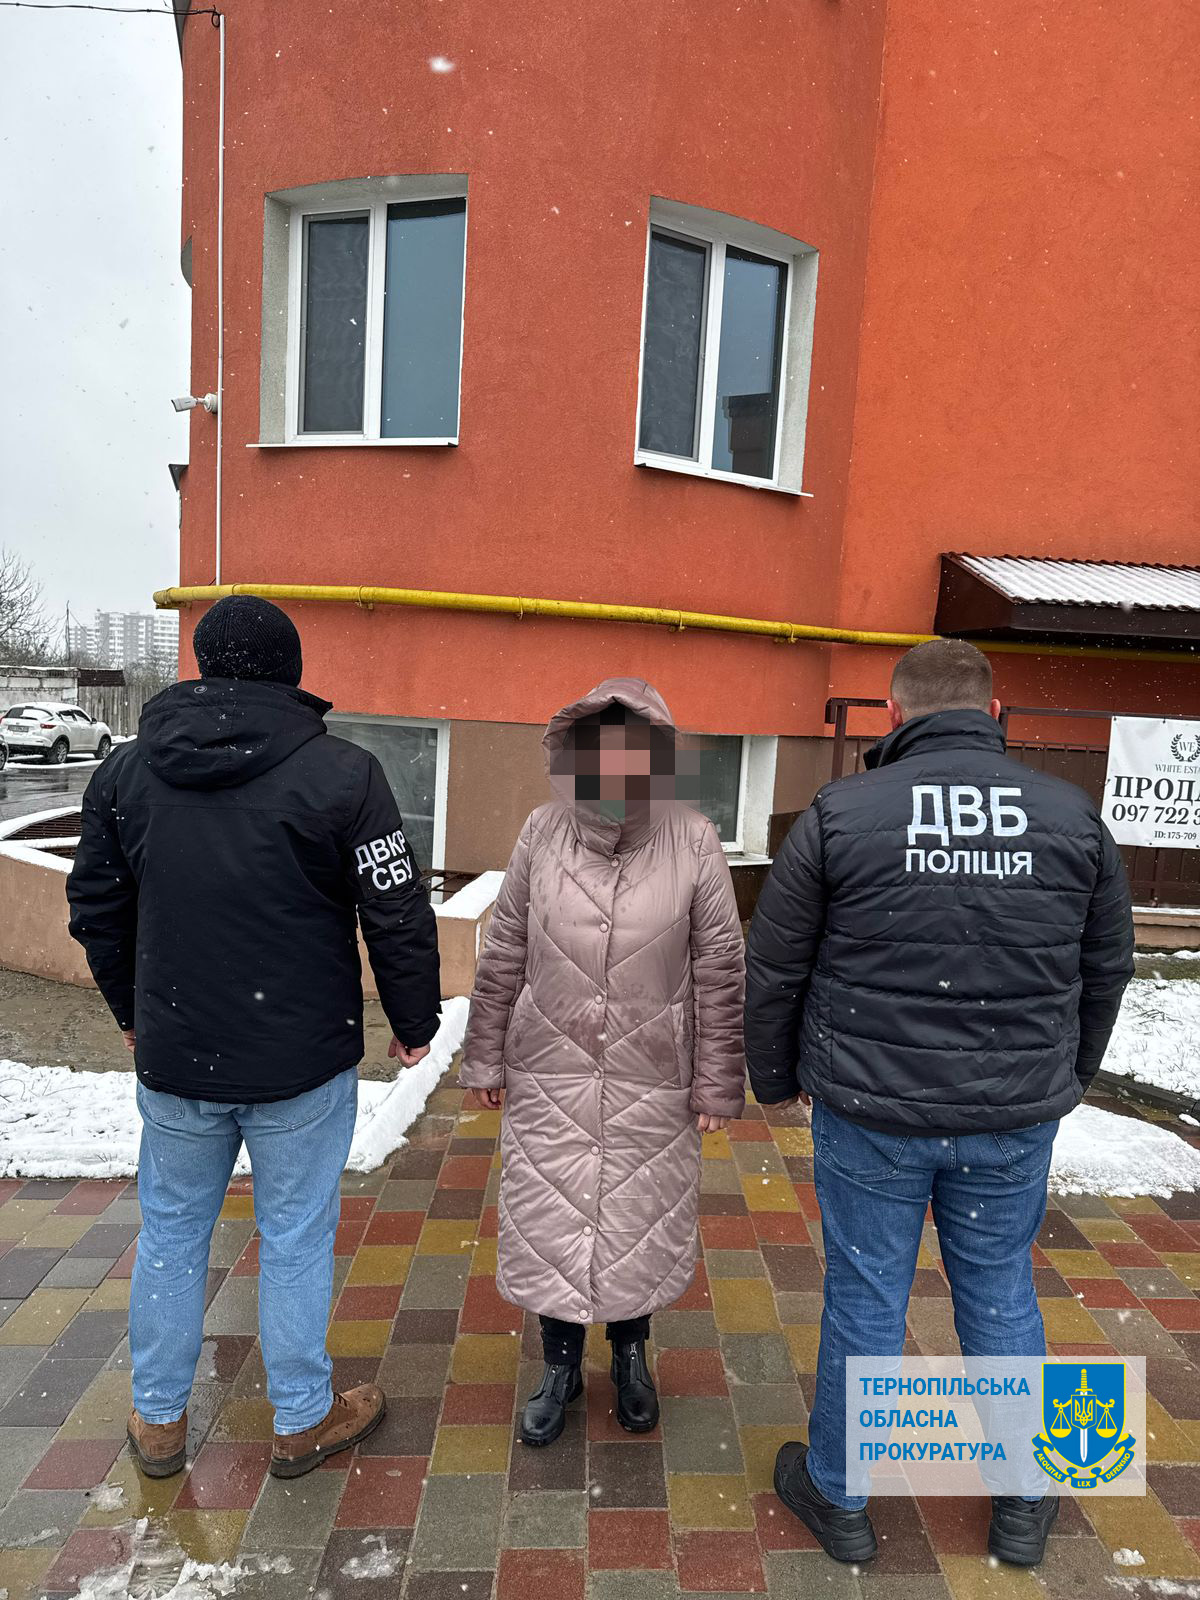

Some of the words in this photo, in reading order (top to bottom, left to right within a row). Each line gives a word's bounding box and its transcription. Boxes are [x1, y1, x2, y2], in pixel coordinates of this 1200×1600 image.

[1179, 741, 1196, 753] WE
[1155, 763, 1182, 774] WHITE
[1112, 775, 1200, 807] ПРОД
[907, 785, 1028, 846] ДВБ
[1112, 803, 1150, 823] 097
[1154, 806, 1189, 825] 722
[1154, 830, 1166, 839] ID:
[1167, 831, 1197, 840] 175-709
[354, 830, 406, 875] ДВКР
[905, 849, 1032, 880] ПОЛІЦІЯ
[371, 855, 413, 891] СБУ
